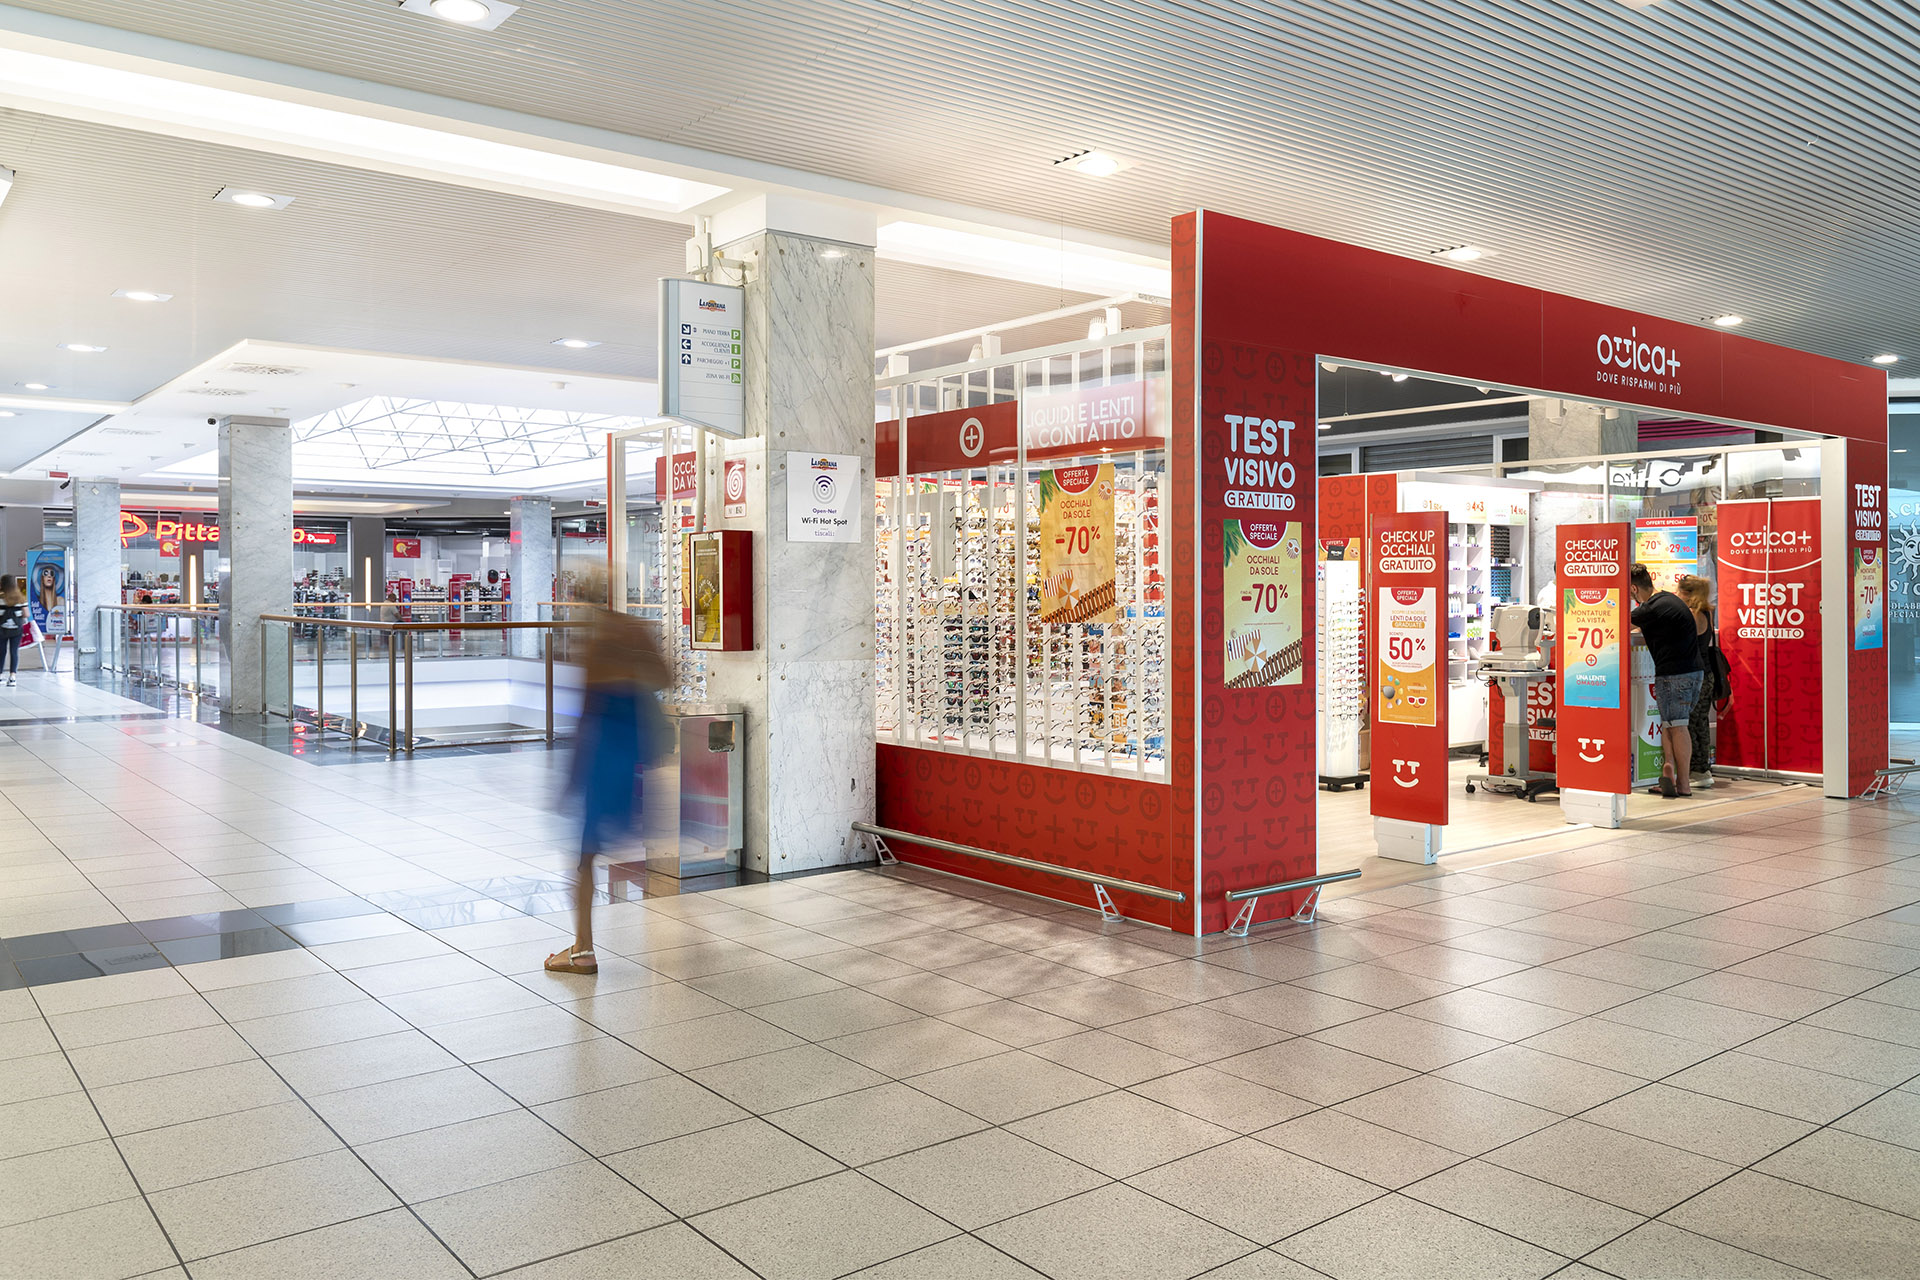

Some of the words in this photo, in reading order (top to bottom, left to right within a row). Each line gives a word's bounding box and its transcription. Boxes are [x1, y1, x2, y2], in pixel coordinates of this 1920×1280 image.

[717, 329, 730, 337] TERRA
[701, 340, 730, 349] ACCOGLIENZA
[696, 357, 724, 365] PARCHEGGIO
[1596, 371, 1618, 384] DOVE
[1621, 375, 1657, 391] RISPARMI
[1659, 382, 1667, 393] DI
[1669, 382, 1681, 395] PIÙ
[1025, 404, 1074, 428] LIQUIDI
[1078, 402, 1088, 422] E
[1092, 396, 1134, 420] LENTI
[1025, 431, 1034, 449] A
[1038, 417, 1136, 447] CONTATTO
[1224, 414, 1296, 457] TEST
[673, 460, 697, 476] OCCH
[1063, 469, 1089, 479] OFFERTA
[1224, 456, 1296, 489] VISIVO
[673, 475, 686, 491] DA
[686, 474, 697, 489] VIS
[1063, 477, 1090, 486] SPECIALE
[1227, 491, 1293, 510] GRATUITO
[1855, 484, 1882, 509] TEST
[1060, 499, 1092, 510] OCCHIALI
[1063, 511, 1072, 520] DA
[1073, 510, 1091, 518] SOLE
[1855, 510, 1882, 528] VISIVO
[820, 517, 832, 525] Hot
[833, 518, 848, 527] Spot
[1249, 522, 1278, 532] OFFERTA
[1055, 526, 1101, 555] -70%
[1249, 532, 1278, 541] SPECIALE
[1380, 531, 1418, 543] CHECK
[1419, 530, 1435, 542] UP
[1856, 530, 1881, 540] GRATUITO
[1380, 543, 1435, 556] OCCHIALI
[1565, 539, 1602, 551] CHECK
[1603, 539, 1618, 550] UP
[1640, 540, 1661, 550] -70%
[1246, 555, 1280, 565] OCCHIALI
[1565, 550, 1619, 562] OCCHIALI
[1249, 566, 1259, 575] DA
[1259, 566, 1279, 576] SOLE
[1382, 559, 1433, 571] GRATUITO
[1566, 564, 1617, 574] GRATUITO
[1241, 583, 1288, 614] -70%
[1737, 583, 1805, 606] TEST
[1737, 608, 1805, 626] VISIVO
[1567, 627, 1615, 649] -70%
[1740, 629, 1802, 638] GRATUITO
[1389, 636, 1426, 661] 50%
